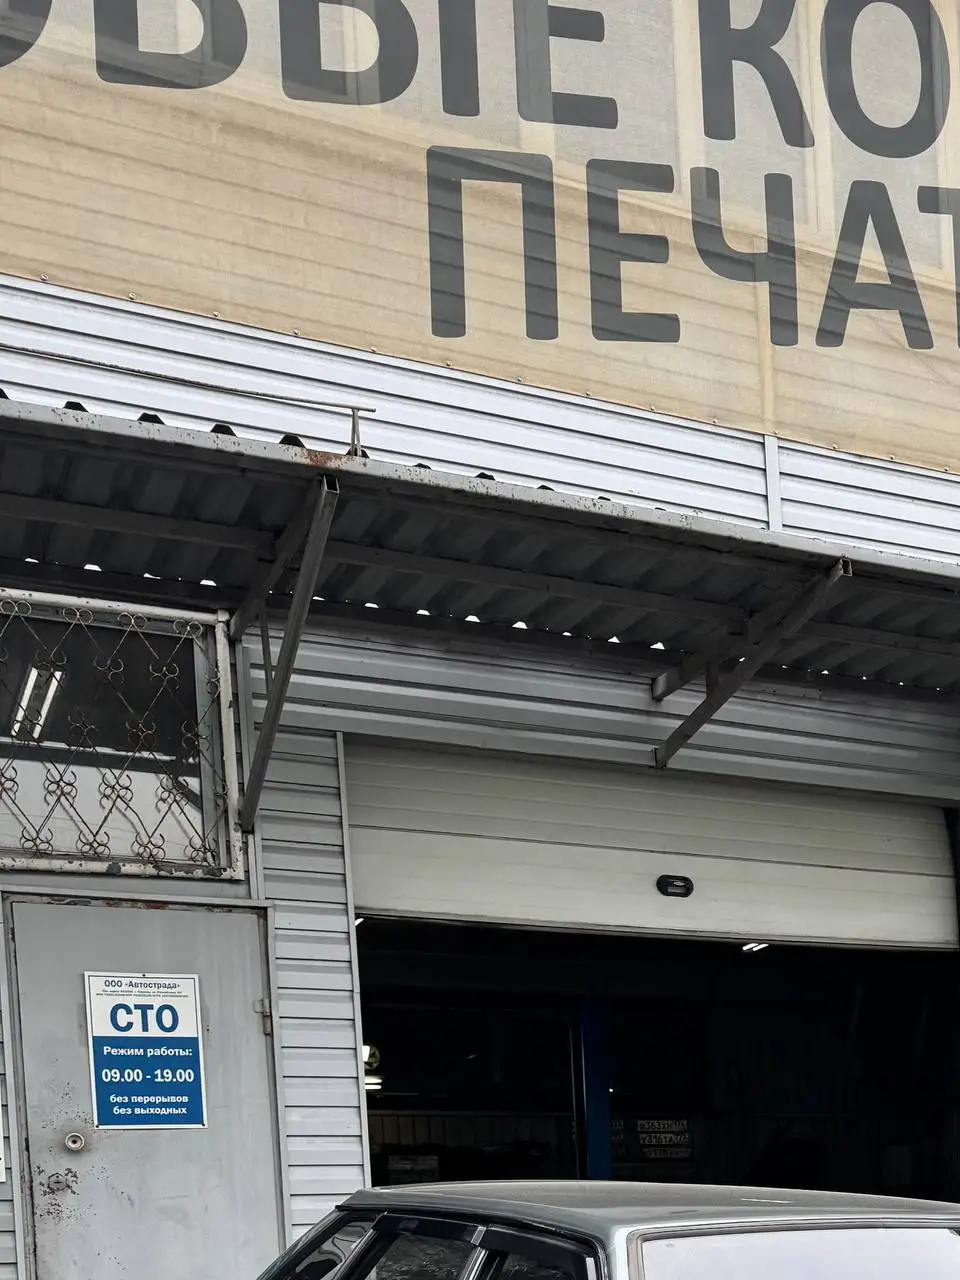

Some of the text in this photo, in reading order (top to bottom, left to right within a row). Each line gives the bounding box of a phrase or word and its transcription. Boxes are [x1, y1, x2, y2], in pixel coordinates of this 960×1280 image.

[104, 979, 122, 988] ООО
[110, 1003, 179, 1032] СТО
[103, 1046, 193, 1057] Режим работы:
[102, 1069, 143, 1082] 09.00
[154, 1069, 195, 1082] 19.00
[110, 1094, 189, 1104] без перерывов
[113, 1106, 188, 1115] без выходных
